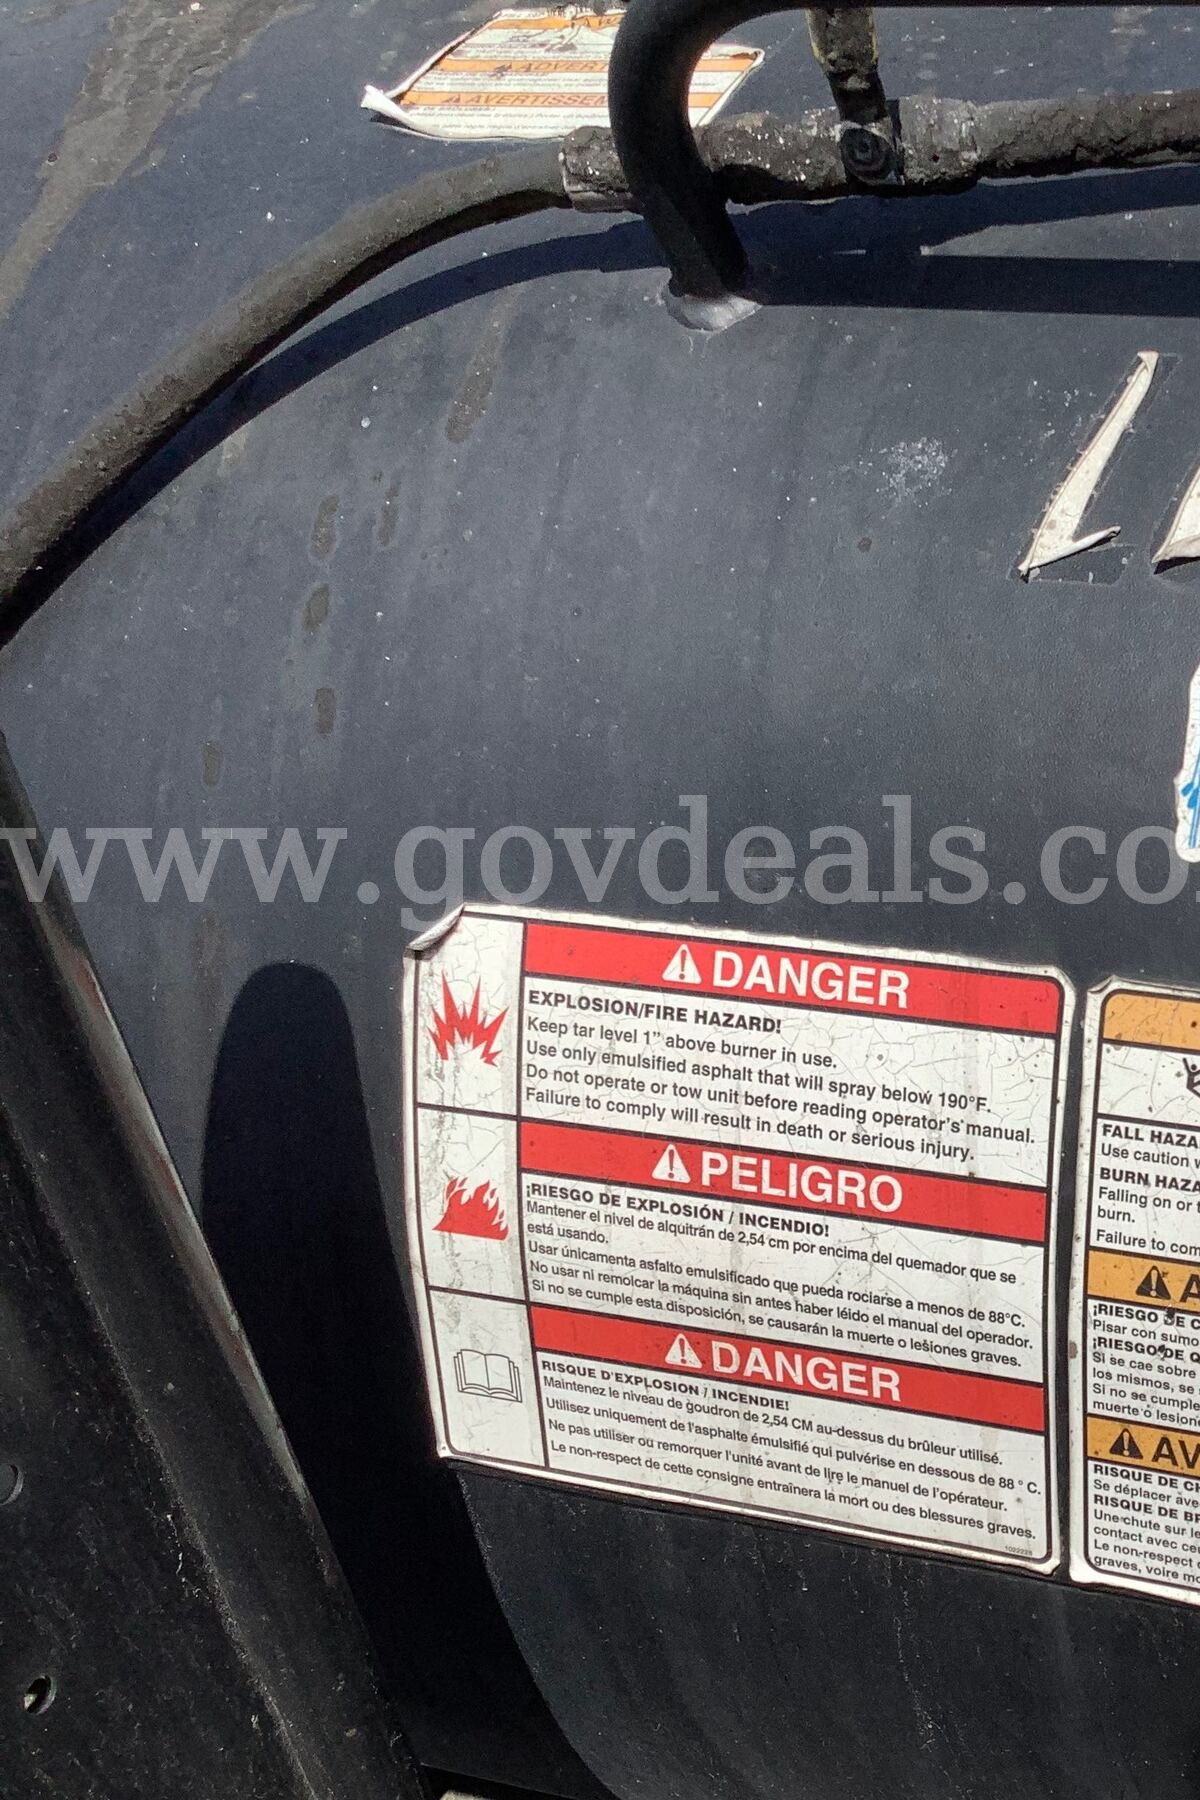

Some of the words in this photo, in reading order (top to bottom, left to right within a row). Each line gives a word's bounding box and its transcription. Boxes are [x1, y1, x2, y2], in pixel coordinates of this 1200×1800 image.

[465, 95, 606, 106] AVERTISSEM
[712, 950, 910, 1009] DANGER
[528, 990, 688, 1021] EXPLOSION/FIRE
[694, 1009, 781, 1033] HAZARD!
[527, 1016, 568, 1038] Keep
[572, 1022, 595, 1038] tar
[599, 1025, 637, 1043] level
[665, 1034, 716, 1053] above
[720, 1039, 777, 1060] burner
[781, 1046, 796, 1063] in
[802, 1052, 837, 1068] use.
[526, 1039, 557, 1057] Use
[561, 1046, 597, 1065] only
[601, 1052, 686, 1073] emulsified
[691, 1063, 753, 1082] asphalt
[757, 1069, 790, 1087] that
[794, 1074, 823, 1091] will
[828, 1080, 876, 1101] spray
[881, 1084, 933, 1105] below
[526, 1063, 548, 1079] Do
[553, 1069, 579, 1084] not
[583, 1074, 645, 1092] operate
[650, 1082, 668, 1095] or
[671, 1082, 702, 1099] tow
[707, 1088, 739, 1104] unit
[743, 1090, 798, 1112] before
[802, 1101, 867, 1125] reading
[965, 1123, 1035, 1143] manual.
[526, 1086, 581, 1107] Failure
[584, 1095, 601, 1110] to
[605, 1100, 666, 1122] comply
[670, 1107, 698, 1123] will
[701, 1113, 751, 1130] result
[756, 1116, 771, 1133] in
[776, 1120, 823, 1139] death
[828, 1129, 847, 1142] or
[850, 1128, 915, 1152] serious
[920, 1138, 974, 1163] injury.
[1102, 1123, 1144, 1141] FALL
[1101, 1142, 1129, 1159] Use
[1133, 1150, 1190, 1167] caution
[701, 1150, 903, 1213] PELIGRO
[1099, 1166, 1151, 1187] BURN
[526, 1182, 594, 1203] ¡RIESGO
[598, 1192, 621, 1207] DE
[626, 1196, 724, 1222] EXPLOSIÓN
[728, 1210, 735, 1223] /
[738, 1212, 829, 1236] INCENDIO!
[1097, 1204, 1135, 1223] burn.
[1098, 1186, 1148, 1208] Falling
[1152, 1196, 1171, 1209] on
[1175, 1200, 1193, 1212] or
[527, 1223, 554, 1236] está
[557, 1227, 609, 1244] usando.
[1096, 1228, 1146, 1248] Failure
[1150, 1237, 1166, 1251] to
[528, 1240, 559, 1256] Usar
[639, 1259, 683, 1275] asfalto
[685, 1266, 770, 1288] emulsificado
[772, 1279, 799, 1298] que
[801, 1284, 844, 1299] pueda
[847, 1290, 902, 1308] rociarse
[905, 1299, 914, 1310] a
[917, 1301, 965, 1318] menos
[967, 1307, 985, 1321] de
[531, 1279, 545, 1291] Si
[547, 1284, 565, 1294] no
[567, 1287, 583, 1297] se
[585, 1289, 633, 1305] cumple
[635, 1297, 664, 1310] esta
[665, 1298, 745, 1325] disposición,
[748, 1314, 764, 1326] se
[766, 1318, 829, 1336] causarán
[831, 1325, 844, 1338] la
[846, 1330, 895, 1346] muerte
[897, 1338, 907, 1348] o
[909, 1337, 968, 1358] lesiones
[970, 1350, 1021, 1367] graves.
[1092, 1318, 1129, 1336] Pisar
[1130, 1327, 1156, 1340] con
[1160, 1332, 1200, 1347] sumo
[541, 1360, 597, 1378] RISQUE
[703, 1387, 708, 1398] /
[711, 1388, 789, 1411] INCENDIE!
[711, 1340, 901, 1402] DANGER
[1092, 1367, 1113, 1380] los
[1116, 1373, 1174, 1393] mismos,
[1178, 1383, 1195, 1395] se
[543, 1375, 606, 1396] Maintenez
[608, 1386, 619, 1399] le
[622, 1390, 664, 1406] niveau
[666, 1396, 683, 1409] de
[685, 1398, 740, 1419] goudron
[742, 1409, 759, 1423] de
[761, 1412, 788, 1427] 2,54
[791, 1417, 813, 1432] CM
[815, 1424, 884, 1444] au-dessus
[886, 1434, 905, 1448] du
[907, 1437, 956, 1456] brûleur
[959, 1448, 1002, 1465] utilisé.
[1093, 1463, 1153, 1485] RISQUE
[1157, 1475, 1180, 1489] DE
[1093, 1478, 1110, 1491] Se
[1113, 1483, 1172, 1502] déplacer
[1093, 1493, 1153, 1514] RISQUE
[1157, 1505, 1178, 1519] DE
